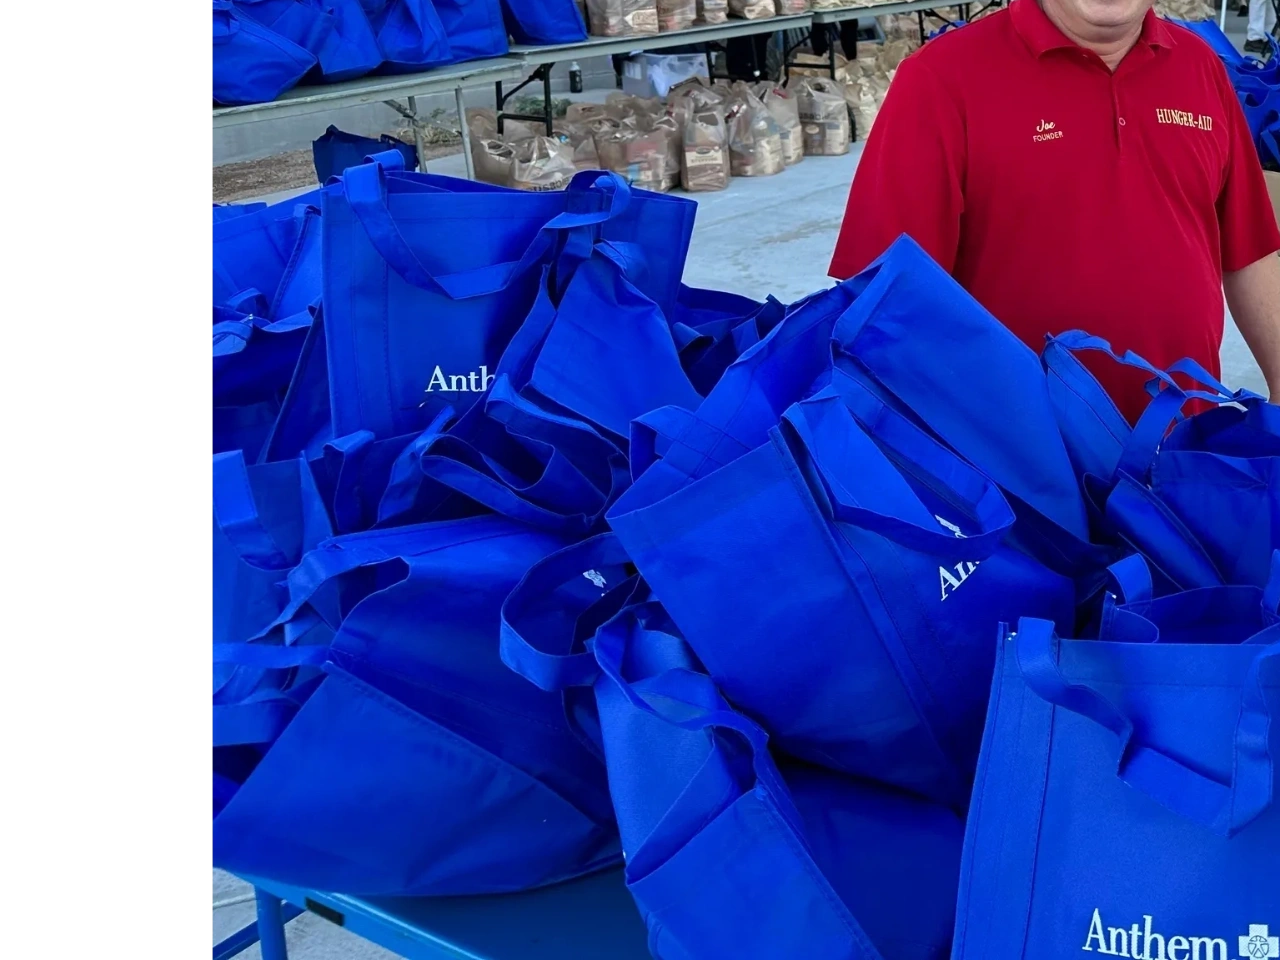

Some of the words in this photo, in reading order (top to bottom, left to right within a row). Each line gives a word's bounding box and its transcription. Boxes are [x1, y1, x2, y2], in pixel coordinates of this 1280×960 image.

[1036, 119, 1056, 132] Joe
[1156, 108, 1212, 131] HUNGER-AID
[1033, 131, 1063, 142] FOUNDER
[1082, 908, 1229, 960] Anthem
